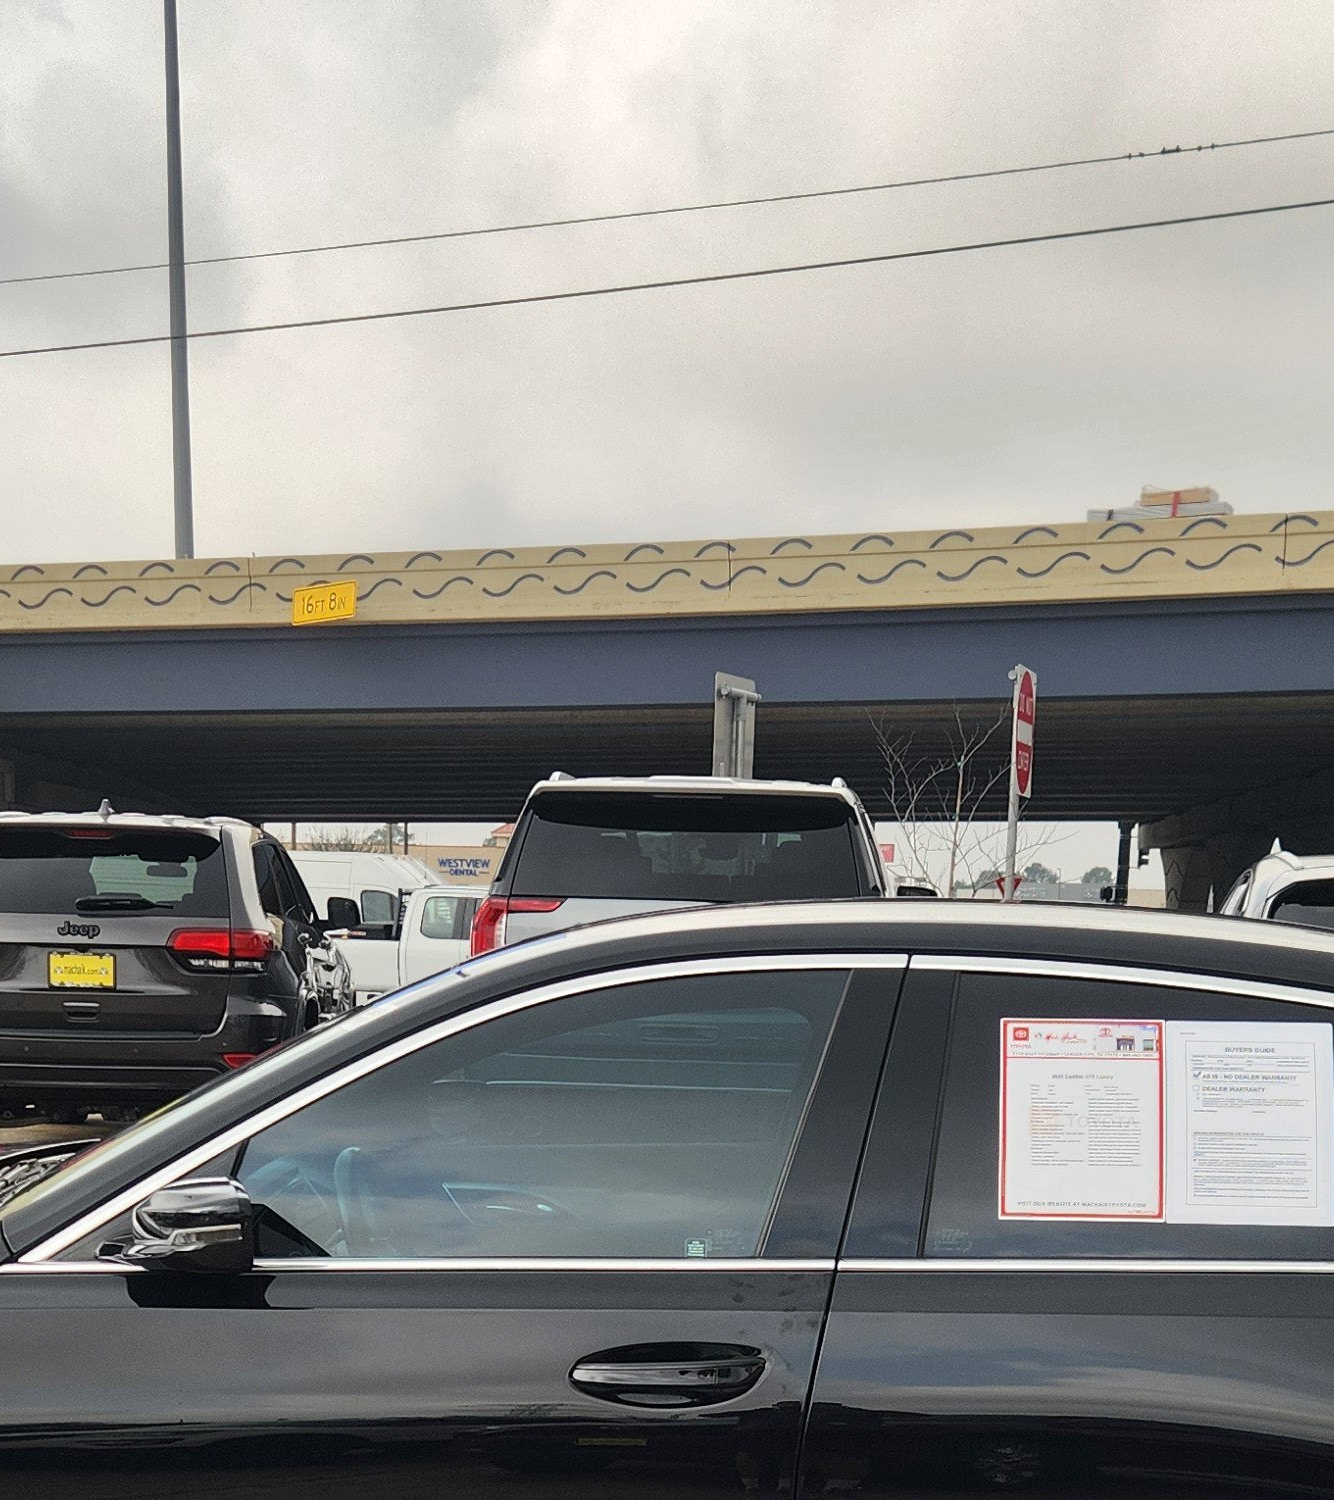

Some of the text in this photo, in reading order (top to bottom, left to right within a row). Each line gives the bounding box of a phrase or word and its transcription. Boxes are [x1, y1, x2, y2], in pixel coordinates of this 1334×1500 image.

[438, 858, 490, 868] WESTVIEW
[449, 868, 478, 876] DENTAL
[57, 921, 100, 938] Jeep
